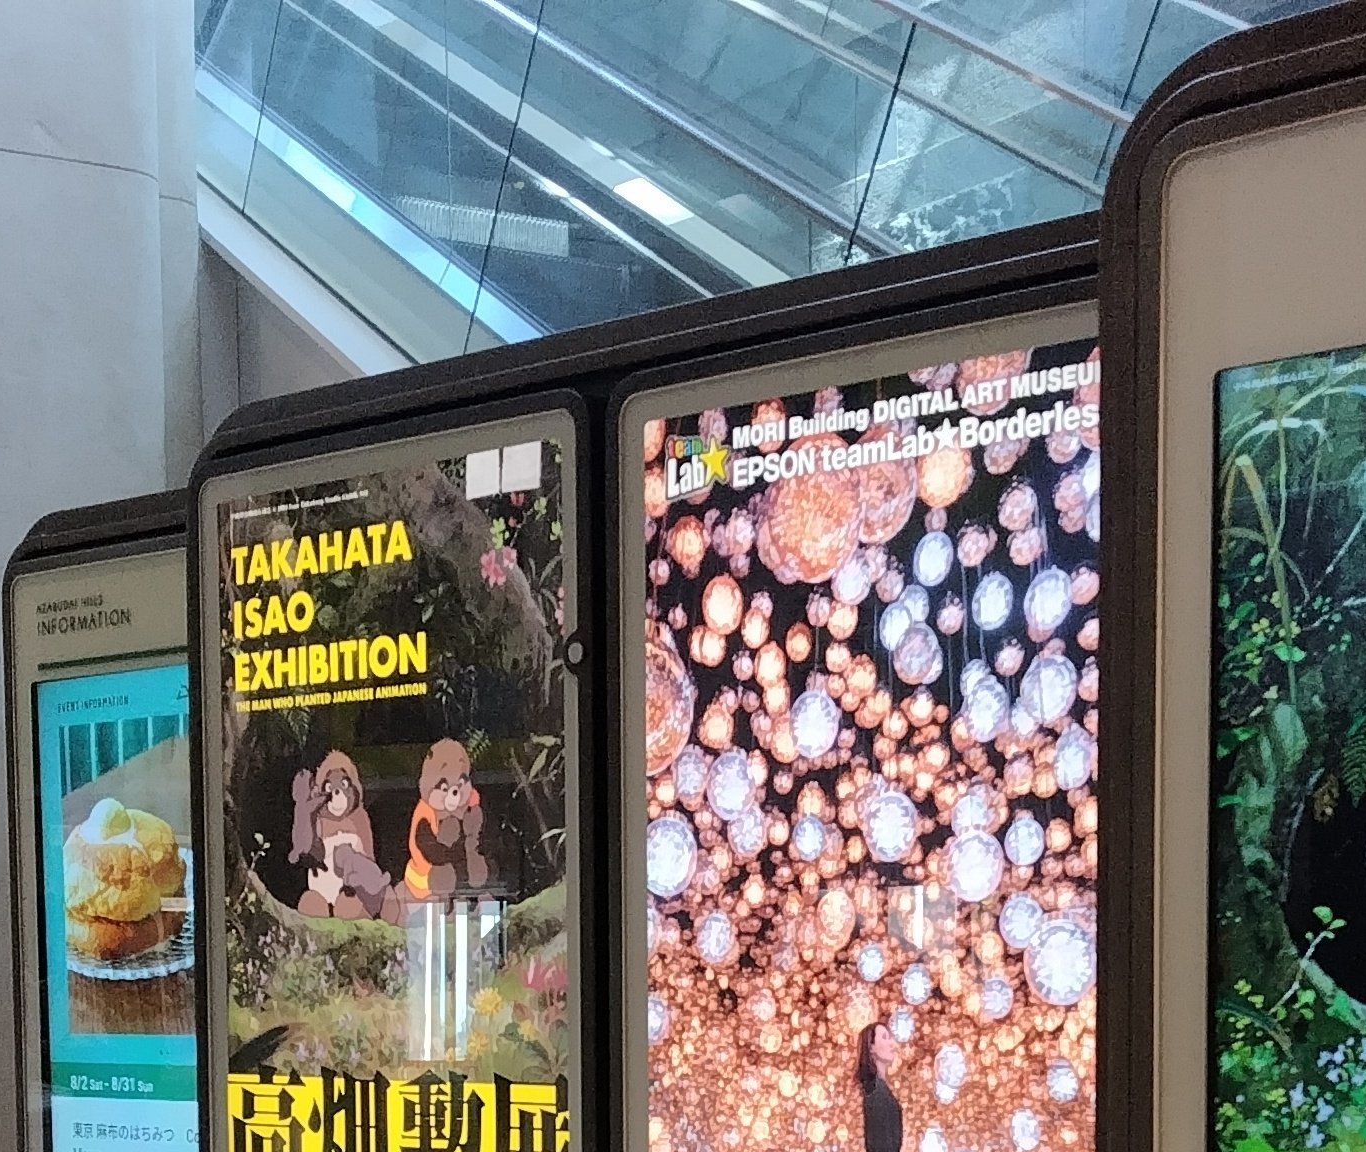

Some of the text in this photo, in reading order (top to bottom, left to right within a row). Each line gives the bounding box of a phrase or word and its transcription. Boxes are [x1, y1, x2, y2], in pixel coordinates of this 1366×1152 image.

[732, 421, 786, 449] MORI
[788, 407, 870, 440] Building
[873, 388, 959, 424] DIGITAL
[961, 378, 1008, 409] ART
[667, 454, 705, 499] Lab
[732, 447, 816, 488] EPSON
[230, 519, 413, 586] TAKAHATA
[37, 608, 132, 636] INFORMATION
[233, 590, 315, 640] ISAO
[235, 631, 427, 692] EXHIBITION
[81, 695, 129, 711] INFORMATION
[236, 682, 427, 713] THE MAN WHO PLANTED JAPANESE ANIMATION
[70, 1075, 88, 1091] 8/2
[111, 1076, 136, 1092] 8/31
[137, 1080, 154, 1093] Sun
